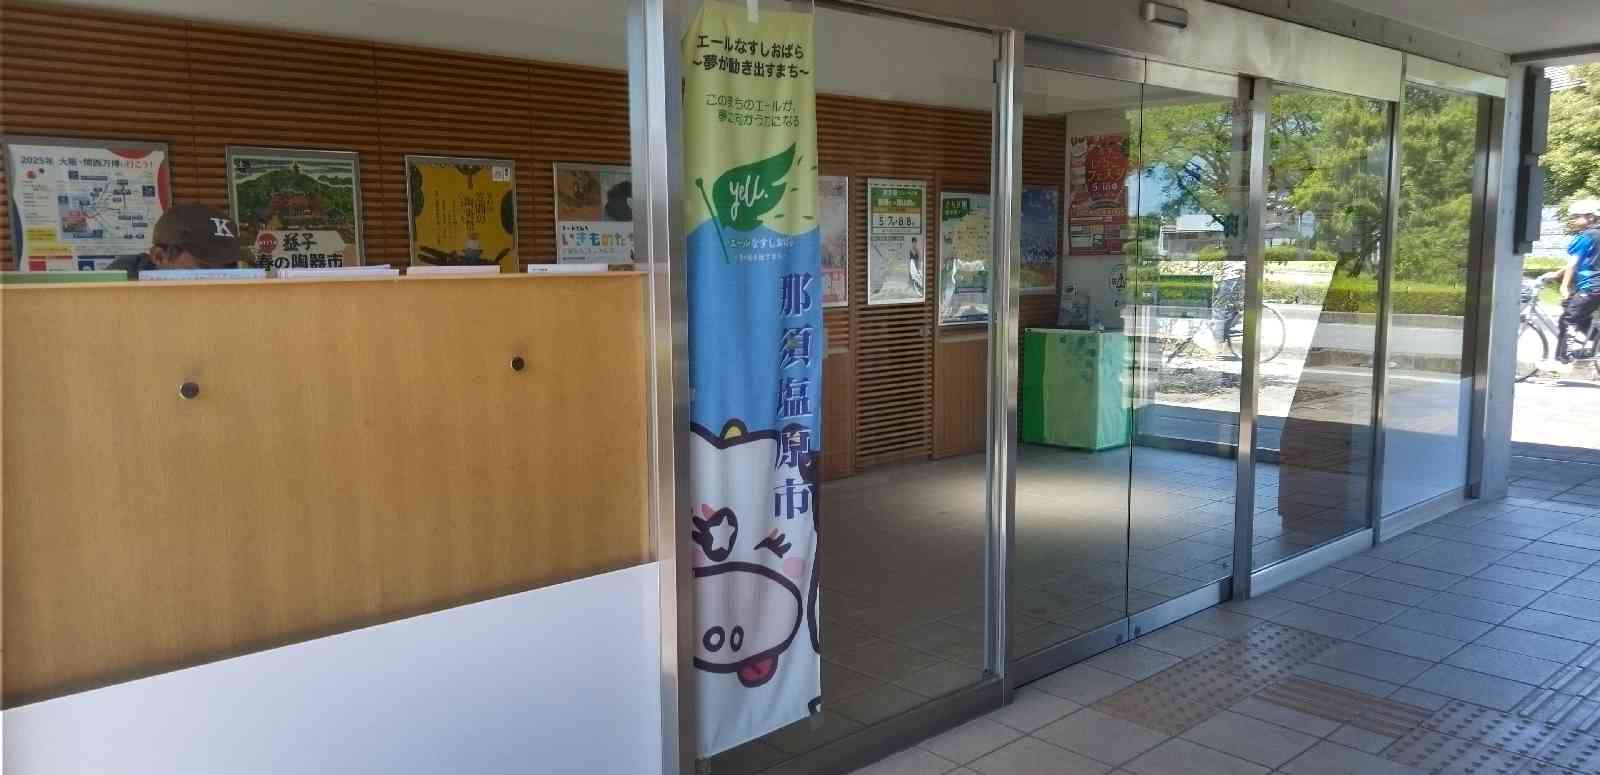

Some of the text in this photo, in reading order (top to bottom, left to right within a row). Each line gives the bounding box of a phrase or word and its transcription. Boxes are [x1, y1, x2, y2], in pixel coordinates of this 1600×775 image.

[696, 35, 805, 59] エールなすしおばら
[210, 217, 235, 238] K
[282, 232, 318, 251] 益子
[255, 253, 344, 271] 春の陶器市
[772, 271, 815, 521] 那須塩原市
